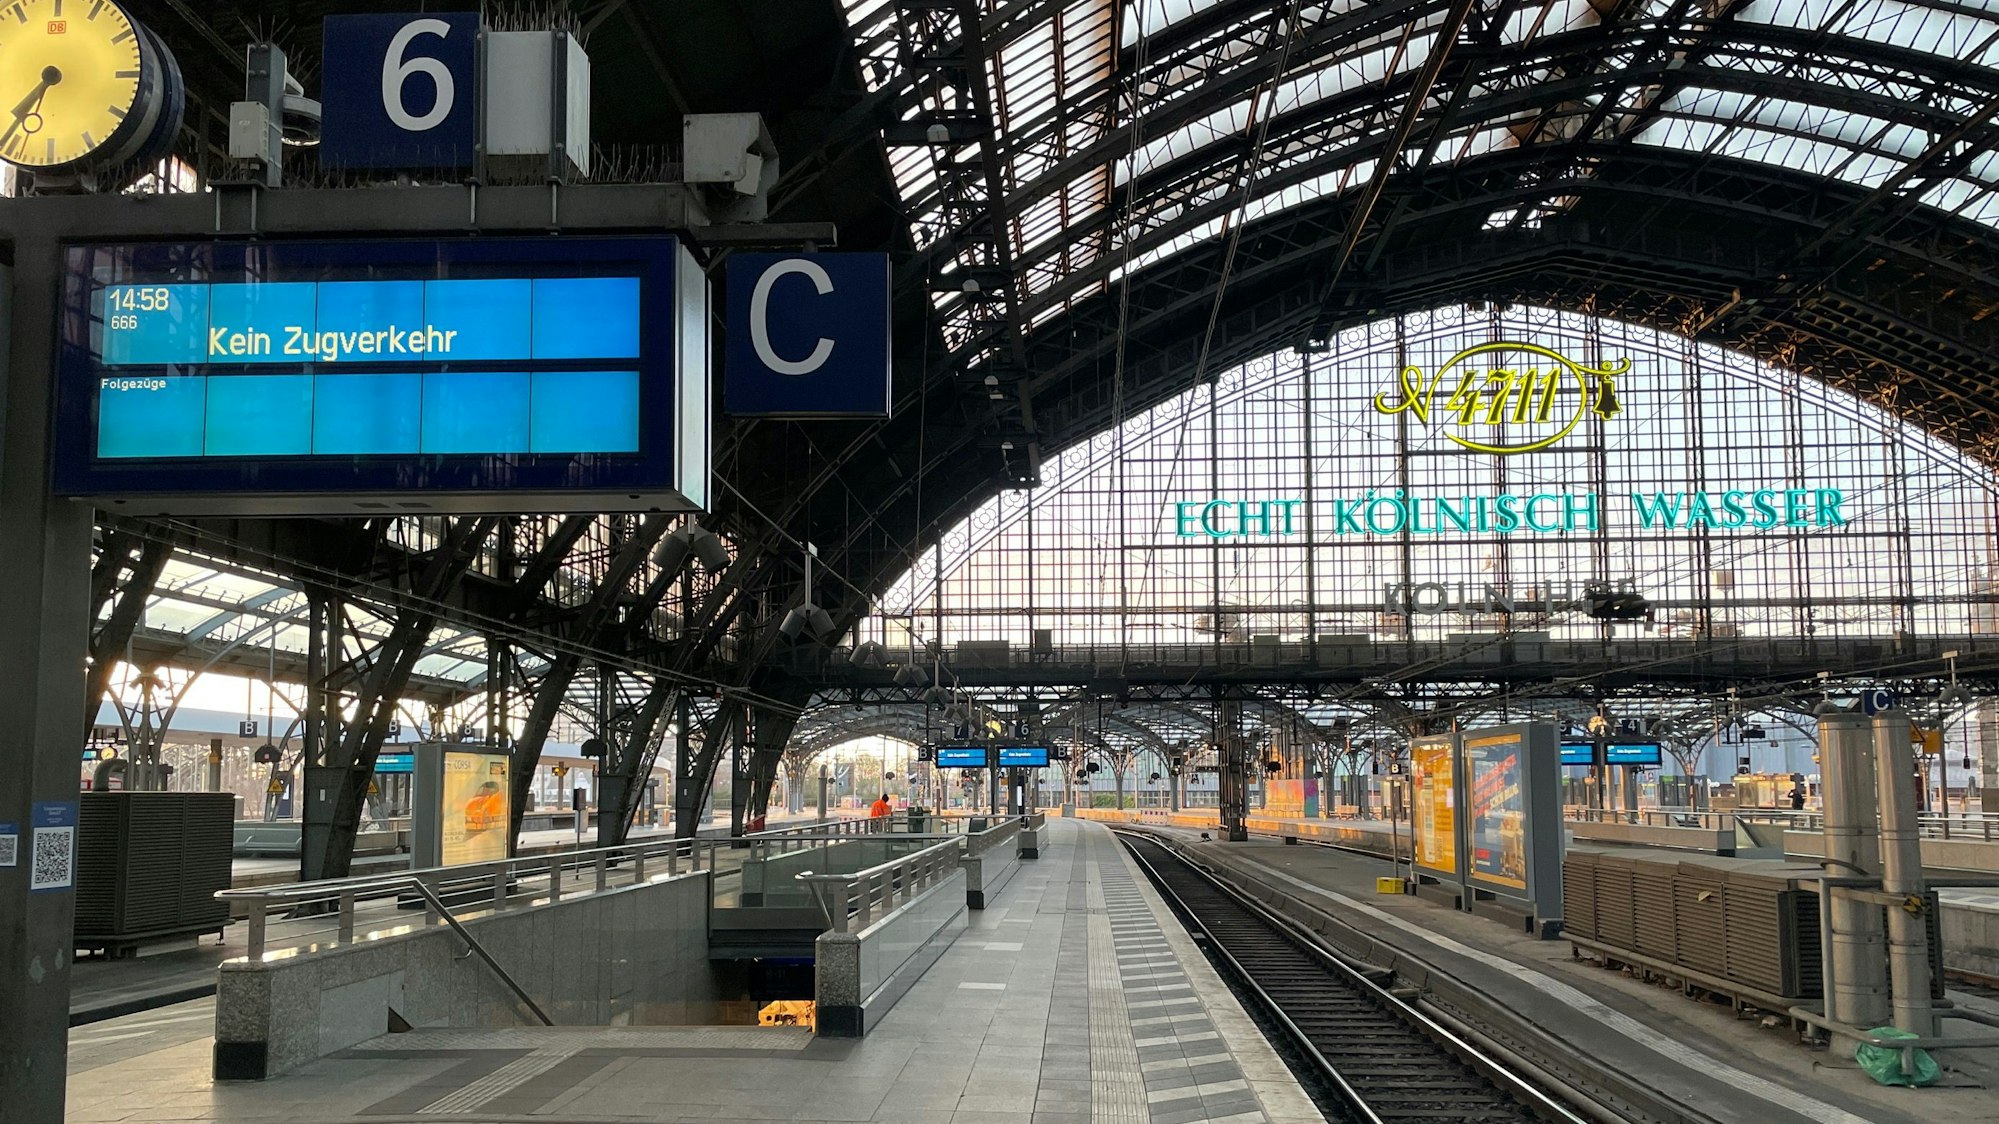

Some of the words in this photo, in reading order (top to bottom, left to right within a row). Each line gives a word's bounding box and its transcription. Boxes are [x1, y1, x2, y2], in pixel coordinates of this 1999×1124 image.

[49, 22, 65, 33] DB
[381, 18, 455, 131] 6
[109, 287, 169, 311] 14:58
[111, 315, 138, 330] 666
[749, 258, 836, 375] C
[208, 327, 271, 356] Kein
[283, 324, 458, 362] Zugverkehr
[101, 377, 167, 391] Folgezüge
[1443, 366, 1563, 426] 4711
[1174, 499, 1302, 538] ECHT
[1334, 488, 1599, 535] KÖLNISCH
[1631, 487, 1847, 530] WASSER
[1872, 690, 1889, 710] C
[245, 722, 254, 735] B
[388, 719, 398, 733] B
[464, 723, 471, 735] 8
[1021, 724, 1029, 736] 6
[1560, 721, 1567, 732] 5
[1627, 720, 1637, 731] 4
[919, 747, 928, 758] B
[1057, 746, 1067, 758] B
[1391, 763, 1399, 773] B
